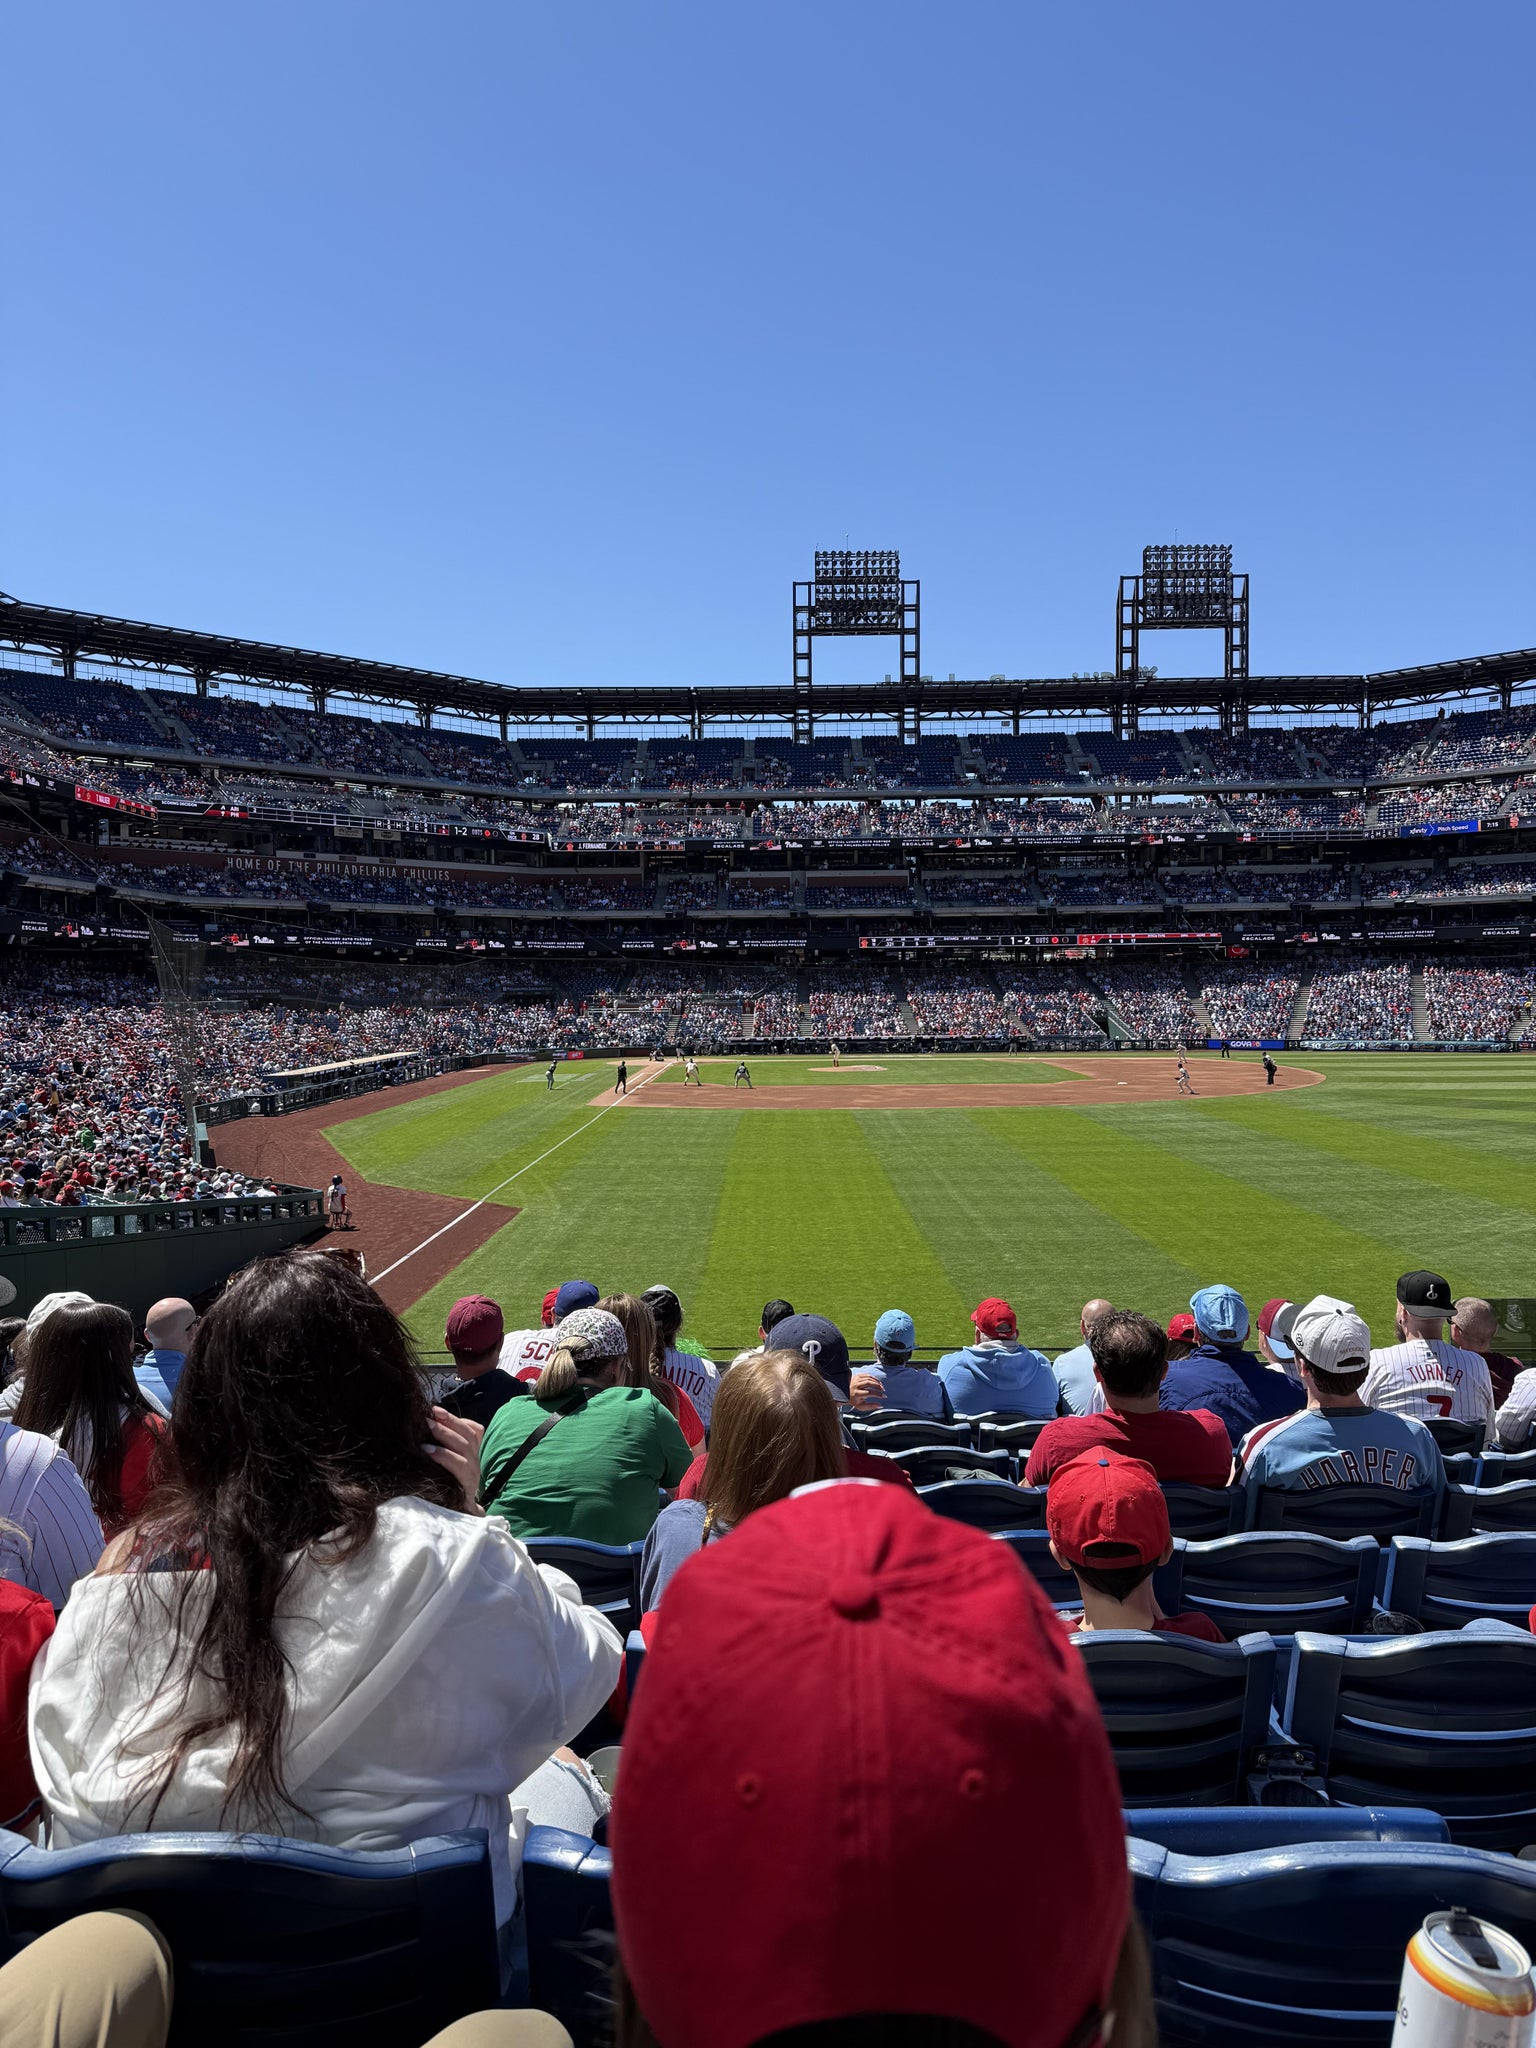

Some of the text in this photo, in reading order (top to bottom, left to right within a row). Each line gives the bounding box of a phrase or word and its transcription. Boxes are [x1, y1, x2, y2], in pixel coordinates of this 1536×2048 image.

[454, 827, 468, 836] 1-2
[974, 838, 993, 846] Phillies
[1166, 834, 1186, 842] Phillies
[227, 857, 261, 870] HOME
[267, 859, 281, 871] OF
[288, 860, 310, 873] THE
[253, 935, 275, 944] Phillies
[1321, 932, 1341, 940] Phillies
[1445, 1044, 1455, 1052] 10
[802, 1339, 822, 1367] P
[1406, 1364, 1464, 1386] TURNER
[1426, 1394, 1452, 1417] 7
[1298, 1446, 1416, 1491] HARPER
